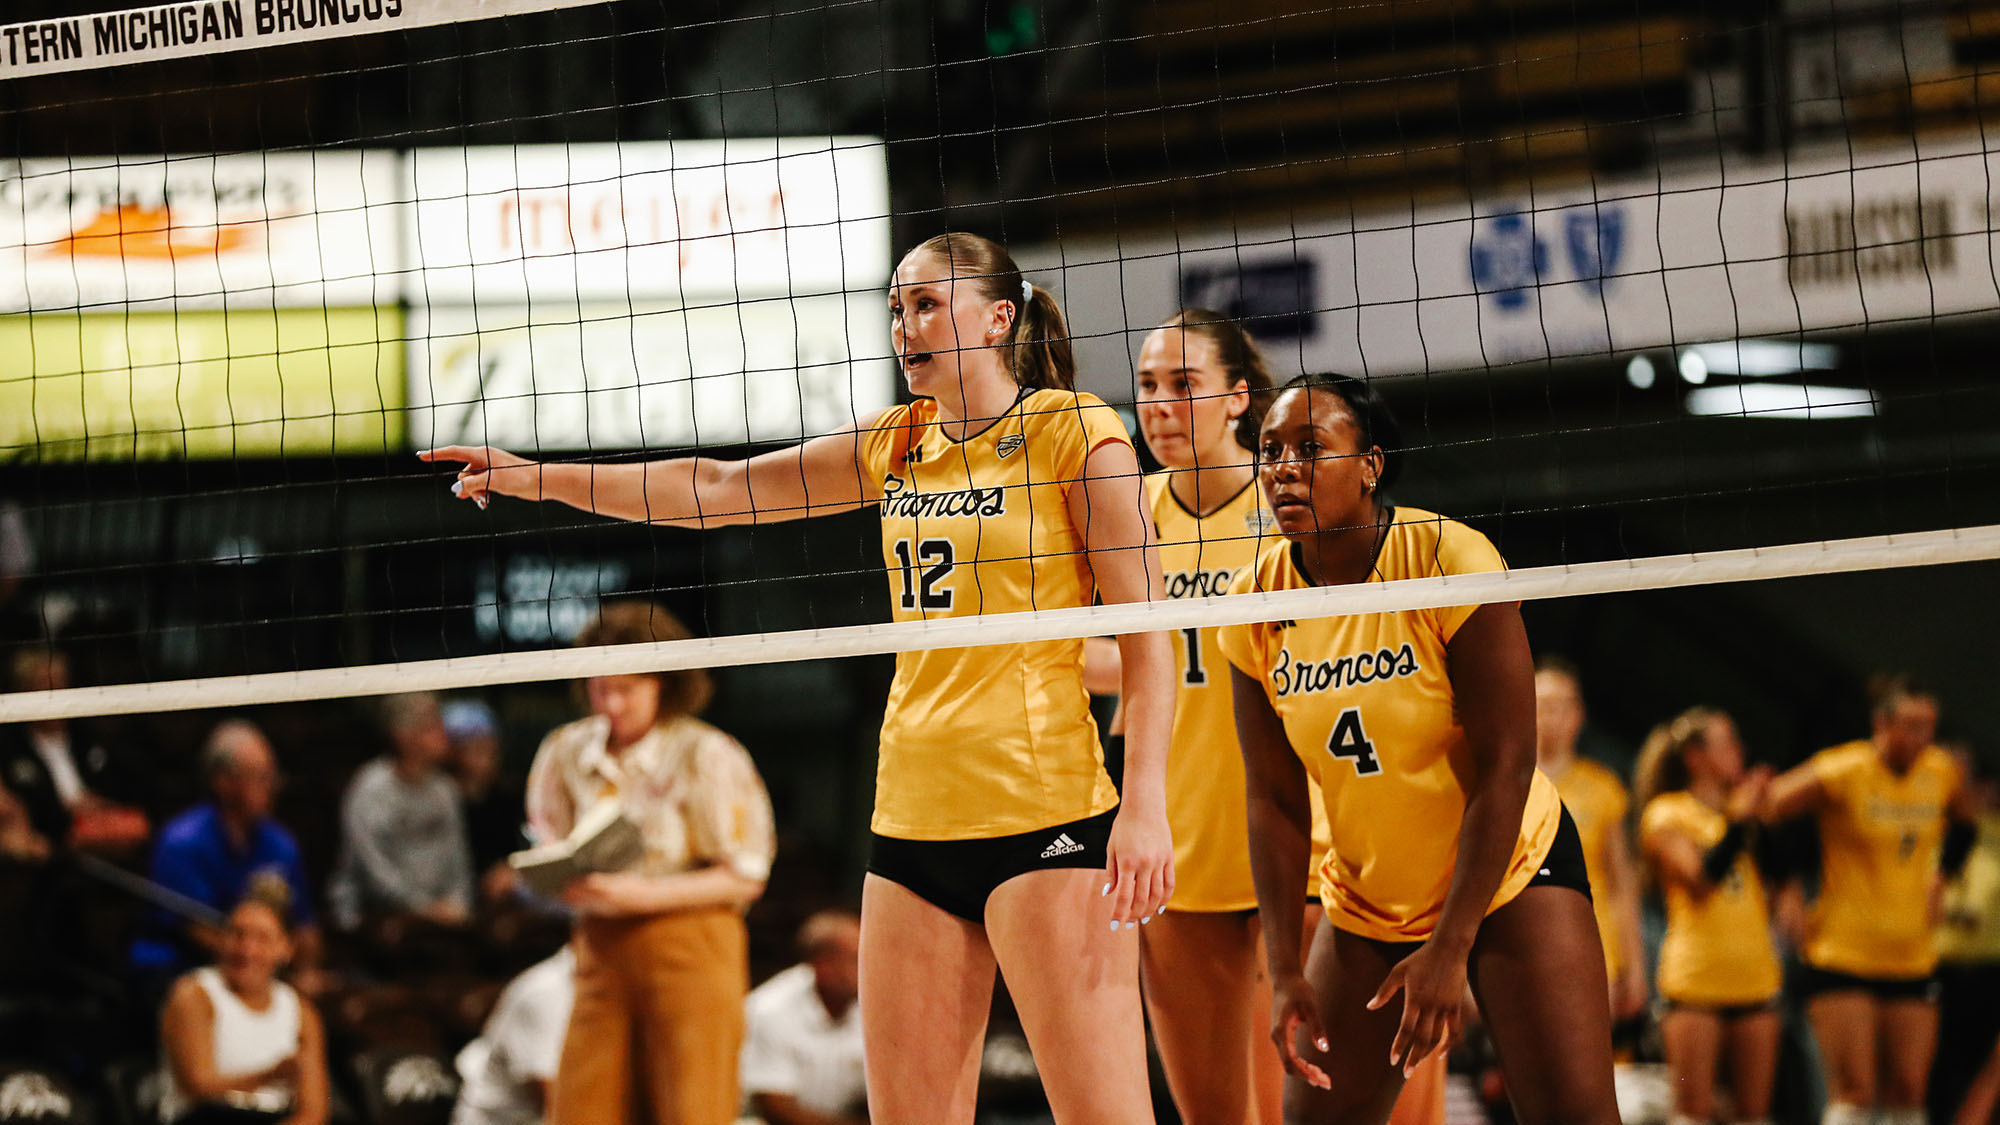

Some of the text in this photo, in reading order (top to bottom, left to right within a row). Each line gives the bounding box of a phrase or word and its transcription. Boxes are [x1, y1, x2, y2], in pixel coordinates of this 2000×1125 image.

[0, 19, 82, 66] TERN
[94, 1, 243, 55] MICHIGAN
[881, 472, 1006, 519] Broncos
[894, 538, 955, 611] 12
[1181, 627, 1209, 688] 1
[1272, 643, 1420, 697] Broncos
[1326, 706, 1383, 777] 4
[1040, 843, 1085, 859] adidas
